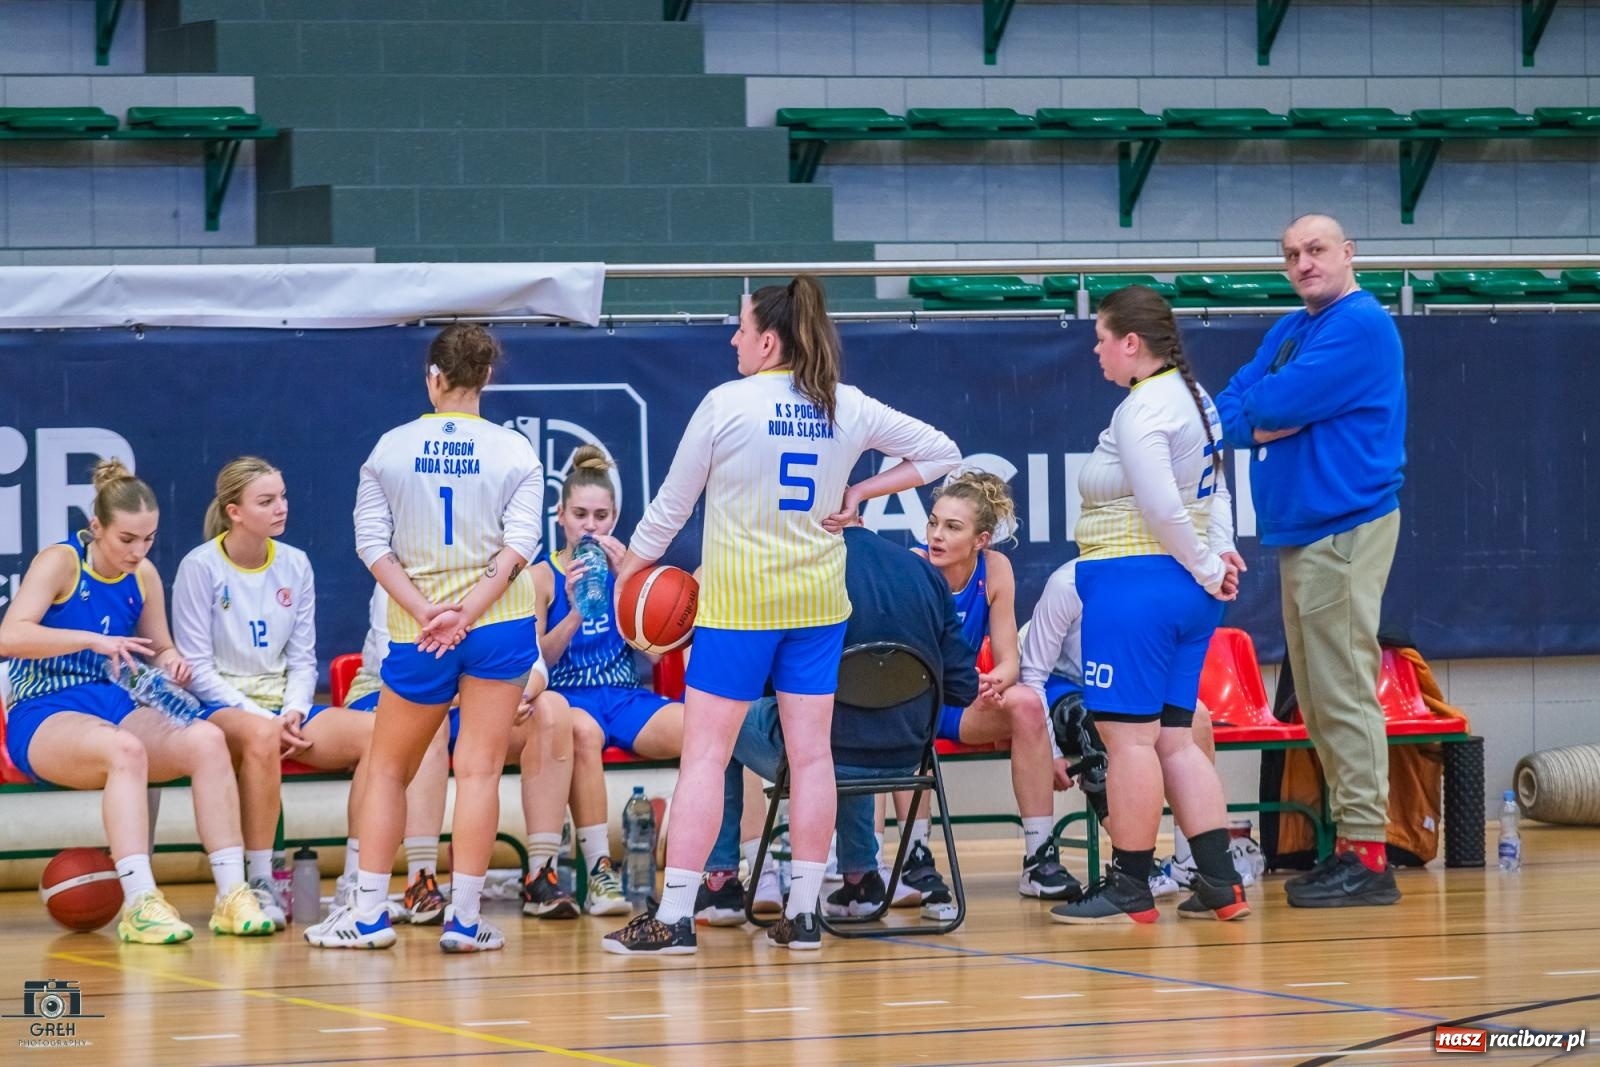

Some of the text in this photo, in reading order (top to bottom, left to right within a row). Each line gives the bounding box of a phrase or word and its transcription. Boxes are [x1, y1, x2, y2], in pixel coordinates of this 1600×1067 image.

[775, 403, 782, 418] K
[785, 403, 792, 418] S
[768, 418, 834, 441] RUDA ŚLĄSKA
[424, 439, 475, 456] K S POGOŃ
[415, 456, 480, 478] RUDA ŚLĄSKA
[779, 452, 818, 512] 5
[440, 486, 453, 545] 1
[676, 590, 697, 627] molten
[249, 620, 268, 648] 12
[1085, 660, 1113, 689] 20
